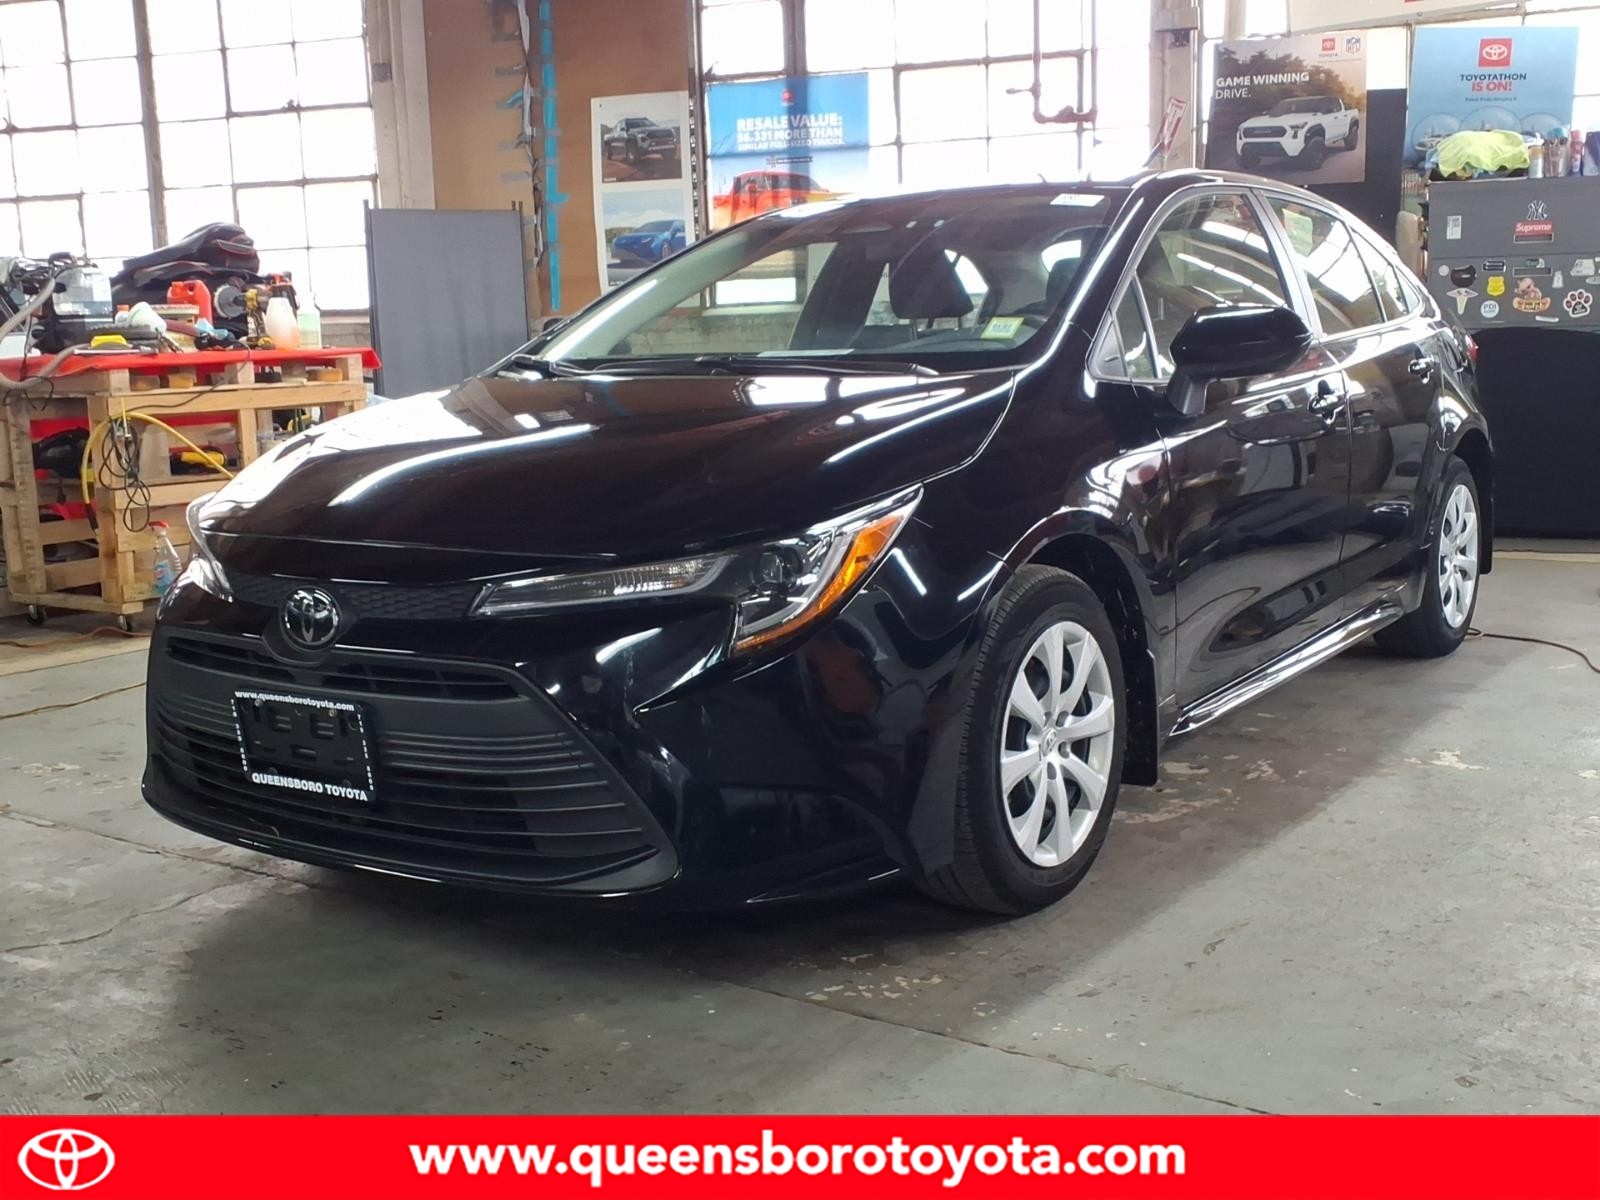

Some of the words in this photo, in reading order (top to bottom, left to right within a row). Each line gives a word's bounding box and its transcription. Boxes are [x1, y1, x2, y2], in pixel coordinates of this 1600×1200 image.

[1216, 75, 1250, 87] GAME
[1253, 72, 1309, 85] WINNING
[1460, 73, 1527, 81] TOYOTATHON
[1472, 82, 1483, 92] IS
[1486, 81, 1512, 91] ON!
[1215, 88, 1251, 99] DRIVE.
[737, 116, 788, 132] RESALE
[790, 112, 843, 127] VALUE:
[773, 128, 807, 141] MORE
[808, 127, 843, 139] THAN
[737, 142, 768, 152] SIMILAR
[1515, 222, 1552, 233] Supreme
[234, 691, 355, 711] www.queensborotoyota.com
[252, 772, 323, 793] QUEENSBORO
[325, 784, 368, 801] TOYOTA
